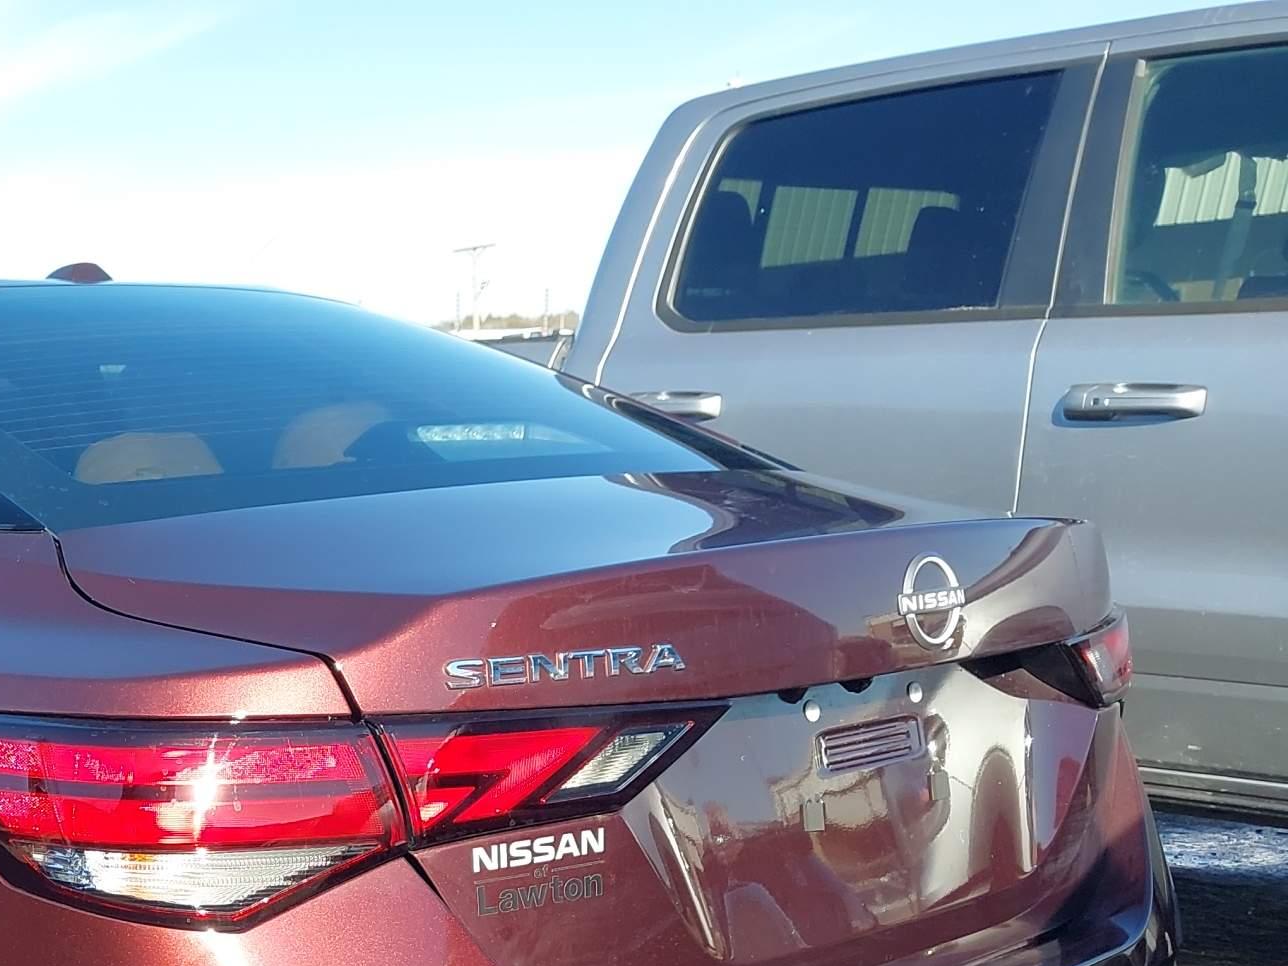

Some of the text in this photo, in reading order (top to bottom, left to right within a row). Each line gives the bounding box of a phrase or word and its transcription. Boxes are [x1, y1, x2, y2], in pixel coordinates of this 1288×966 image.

[901, 588, 965, 612] NISSAN
[443, 643, 686, 690] SENTRA
[472, 827, 605, 873] NISSAN
[533, 864, 549, 879] of
[476, 873, 604, 917] Lawton
